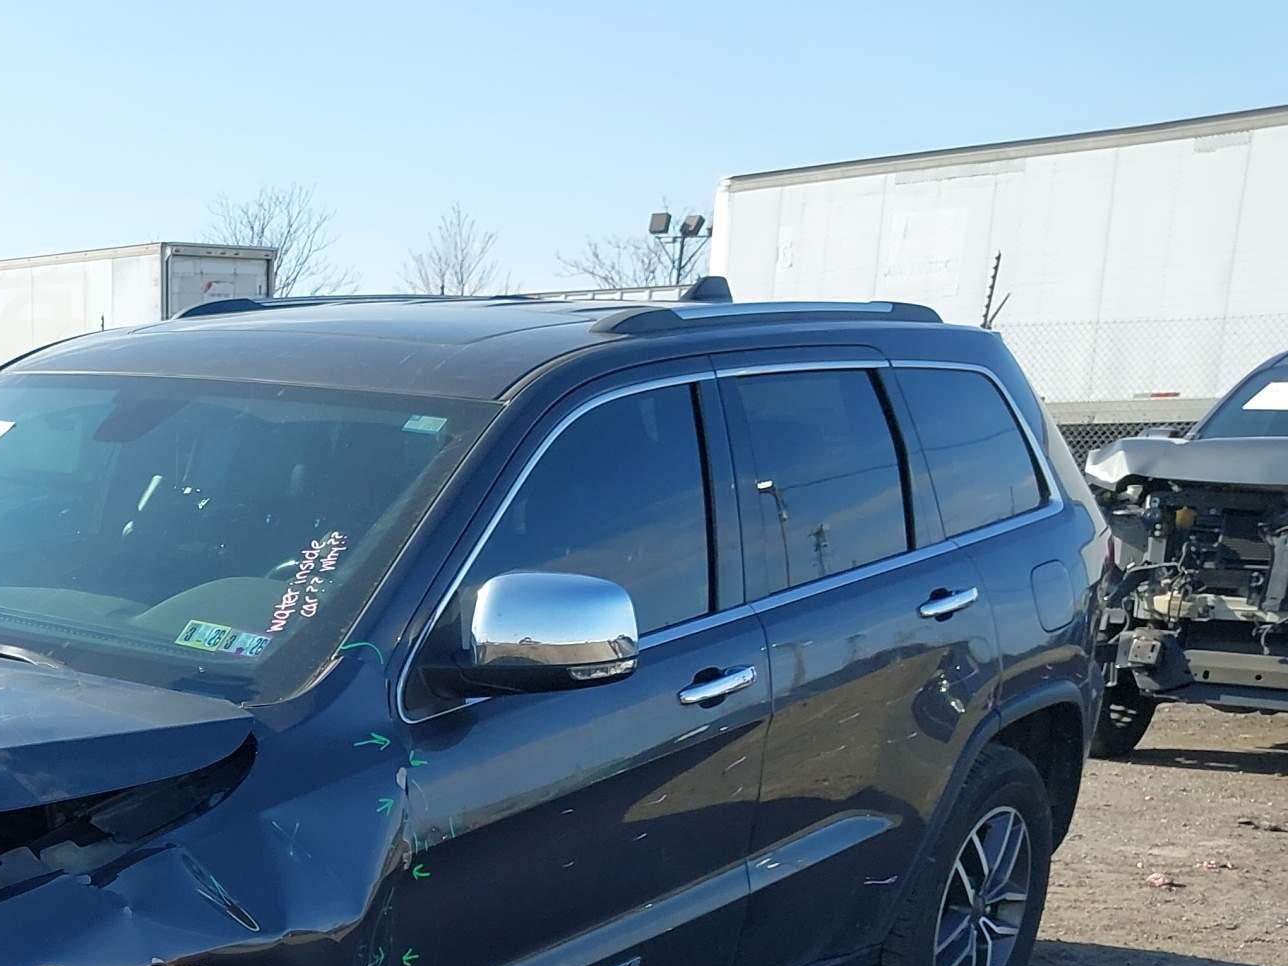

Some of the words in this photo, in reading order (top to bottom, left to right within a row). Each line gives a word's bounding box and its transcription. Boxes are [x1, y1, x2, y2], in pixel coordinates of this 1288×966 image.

[184, 627, 198, 642] 3
[207, 629, 227, 647] 26
[224, 634, 238, 650] 3
